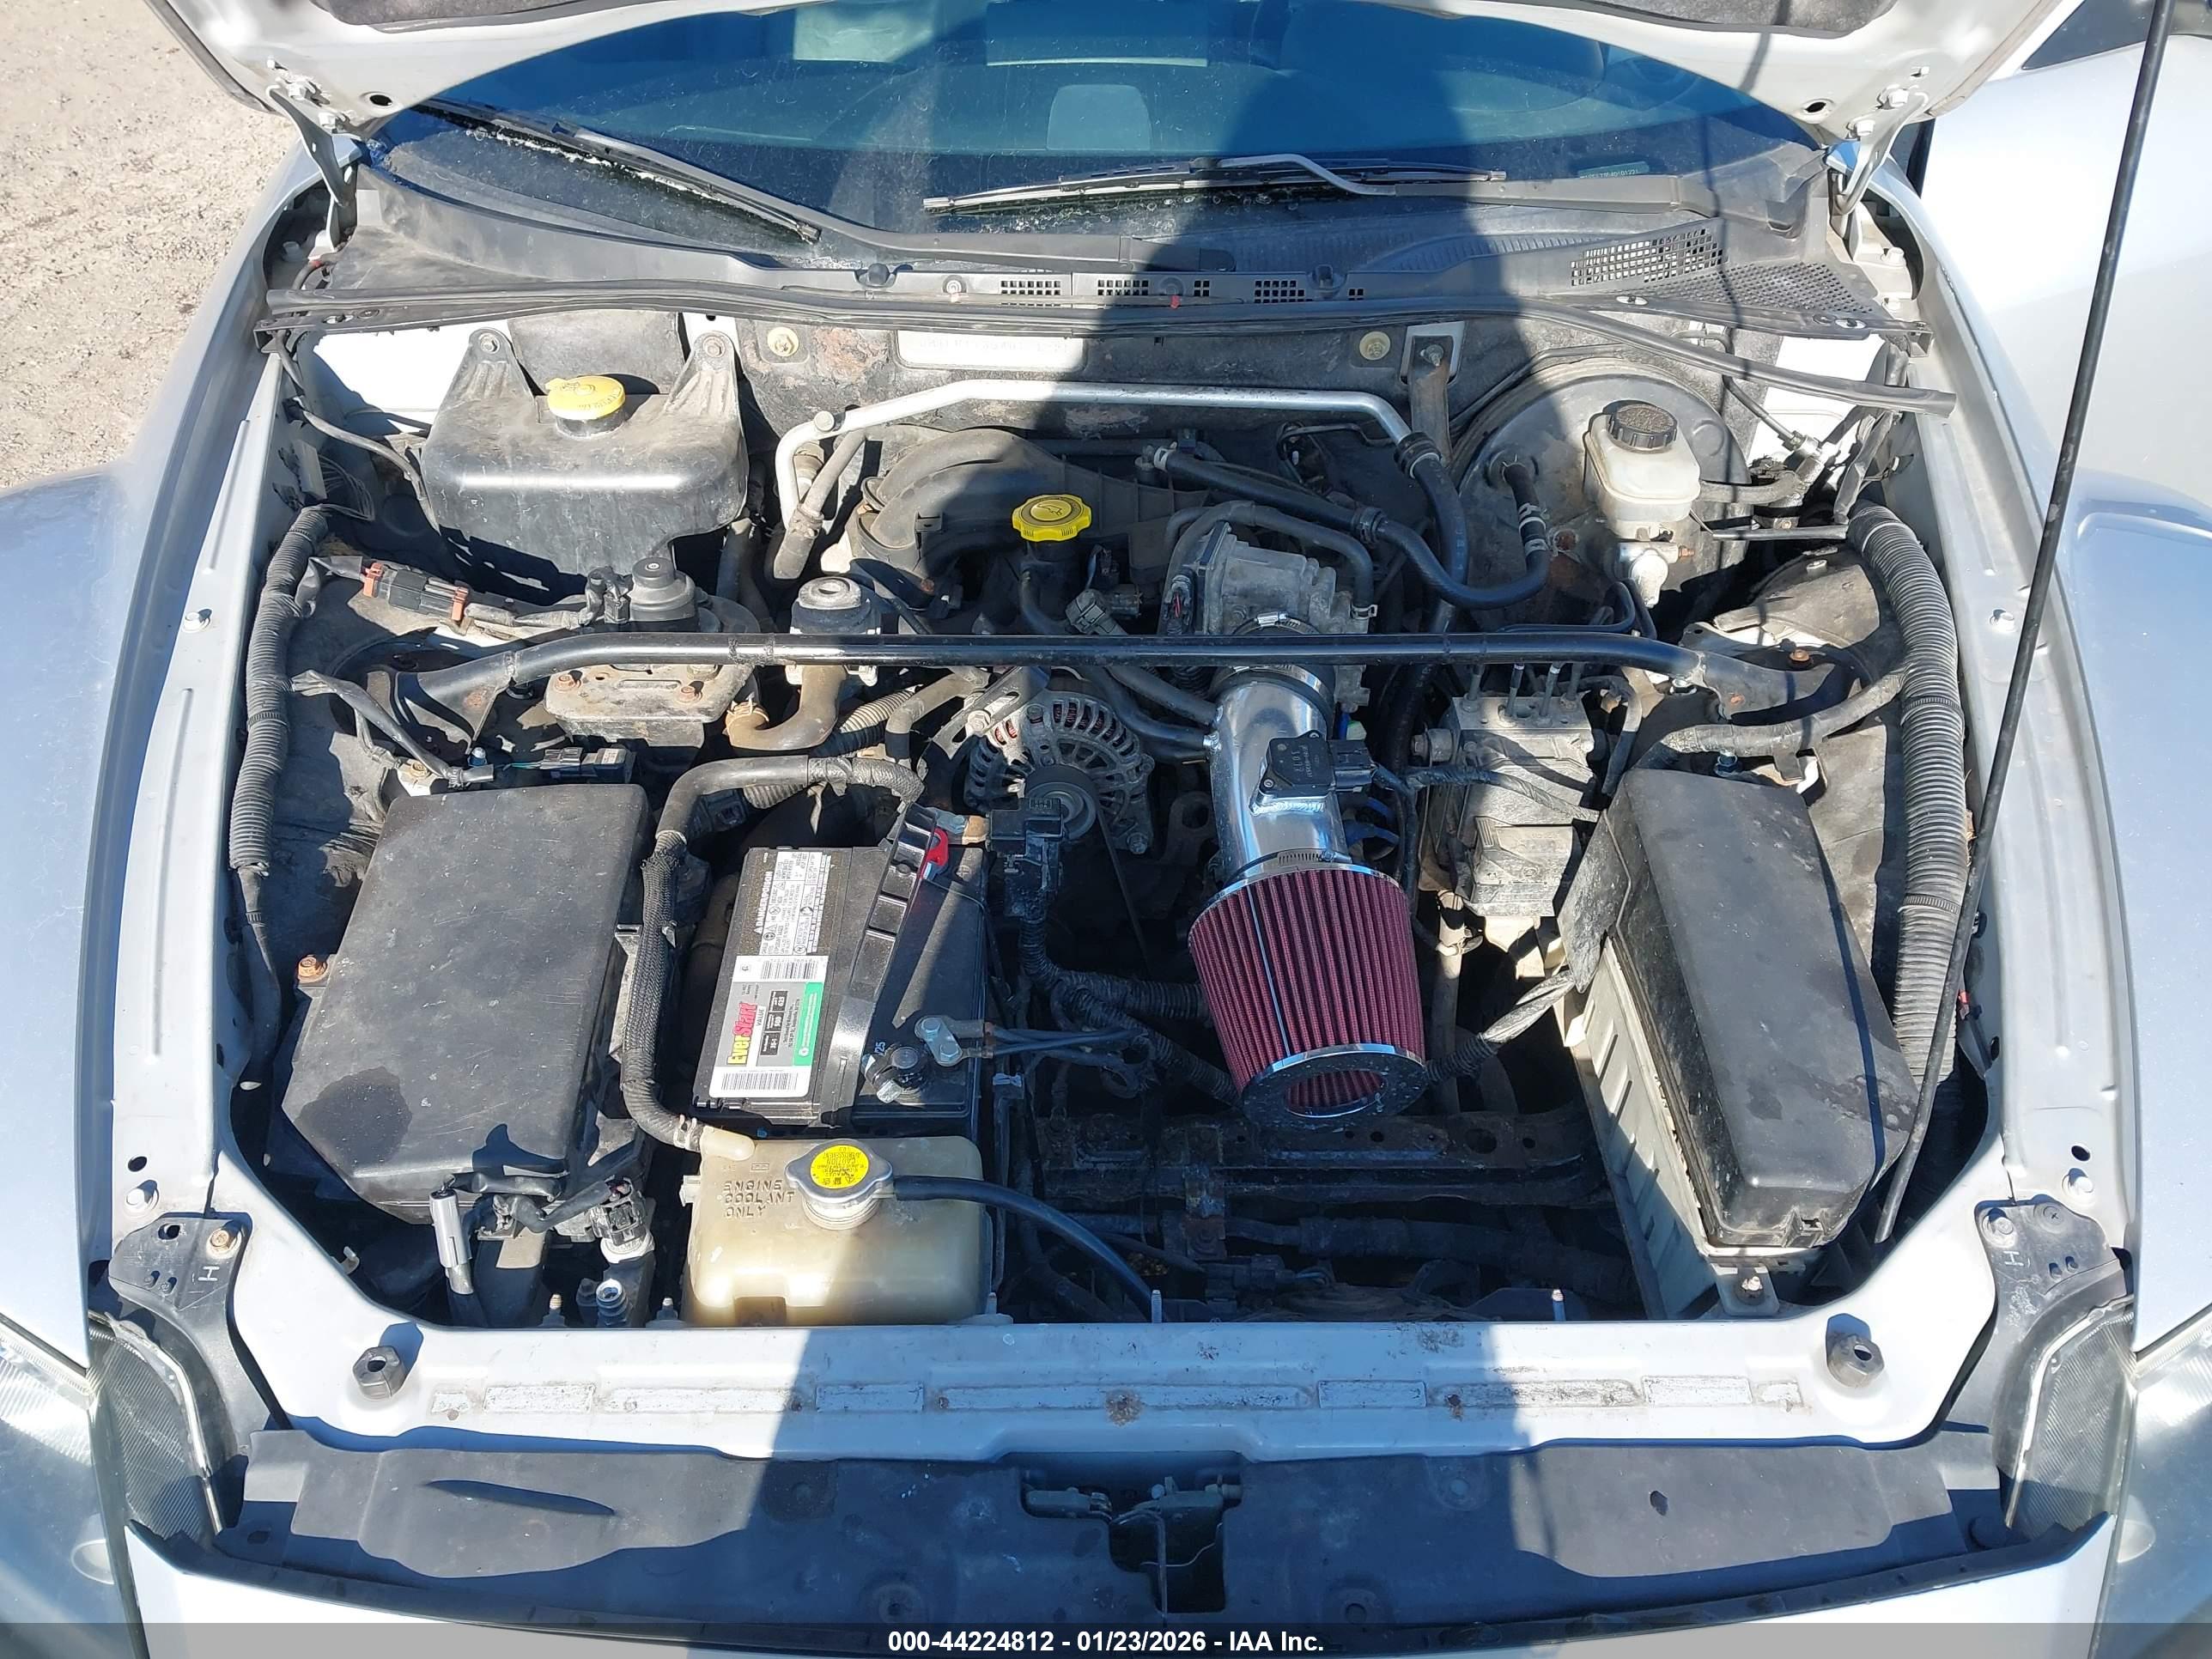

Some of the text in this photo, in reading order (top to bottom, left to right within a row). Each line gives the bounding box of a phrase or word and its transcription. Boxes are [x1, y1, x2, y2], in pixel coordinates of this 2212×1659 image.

[757, 1008, 765, 1026] VALUE
[727, 1003, 757, 1066] EverStart
[723, 1180, 783, 1192] ENGINE
[724, 1191, 795, 1204] COOLANT
[725, 1205, 767, 1218] ONLY
